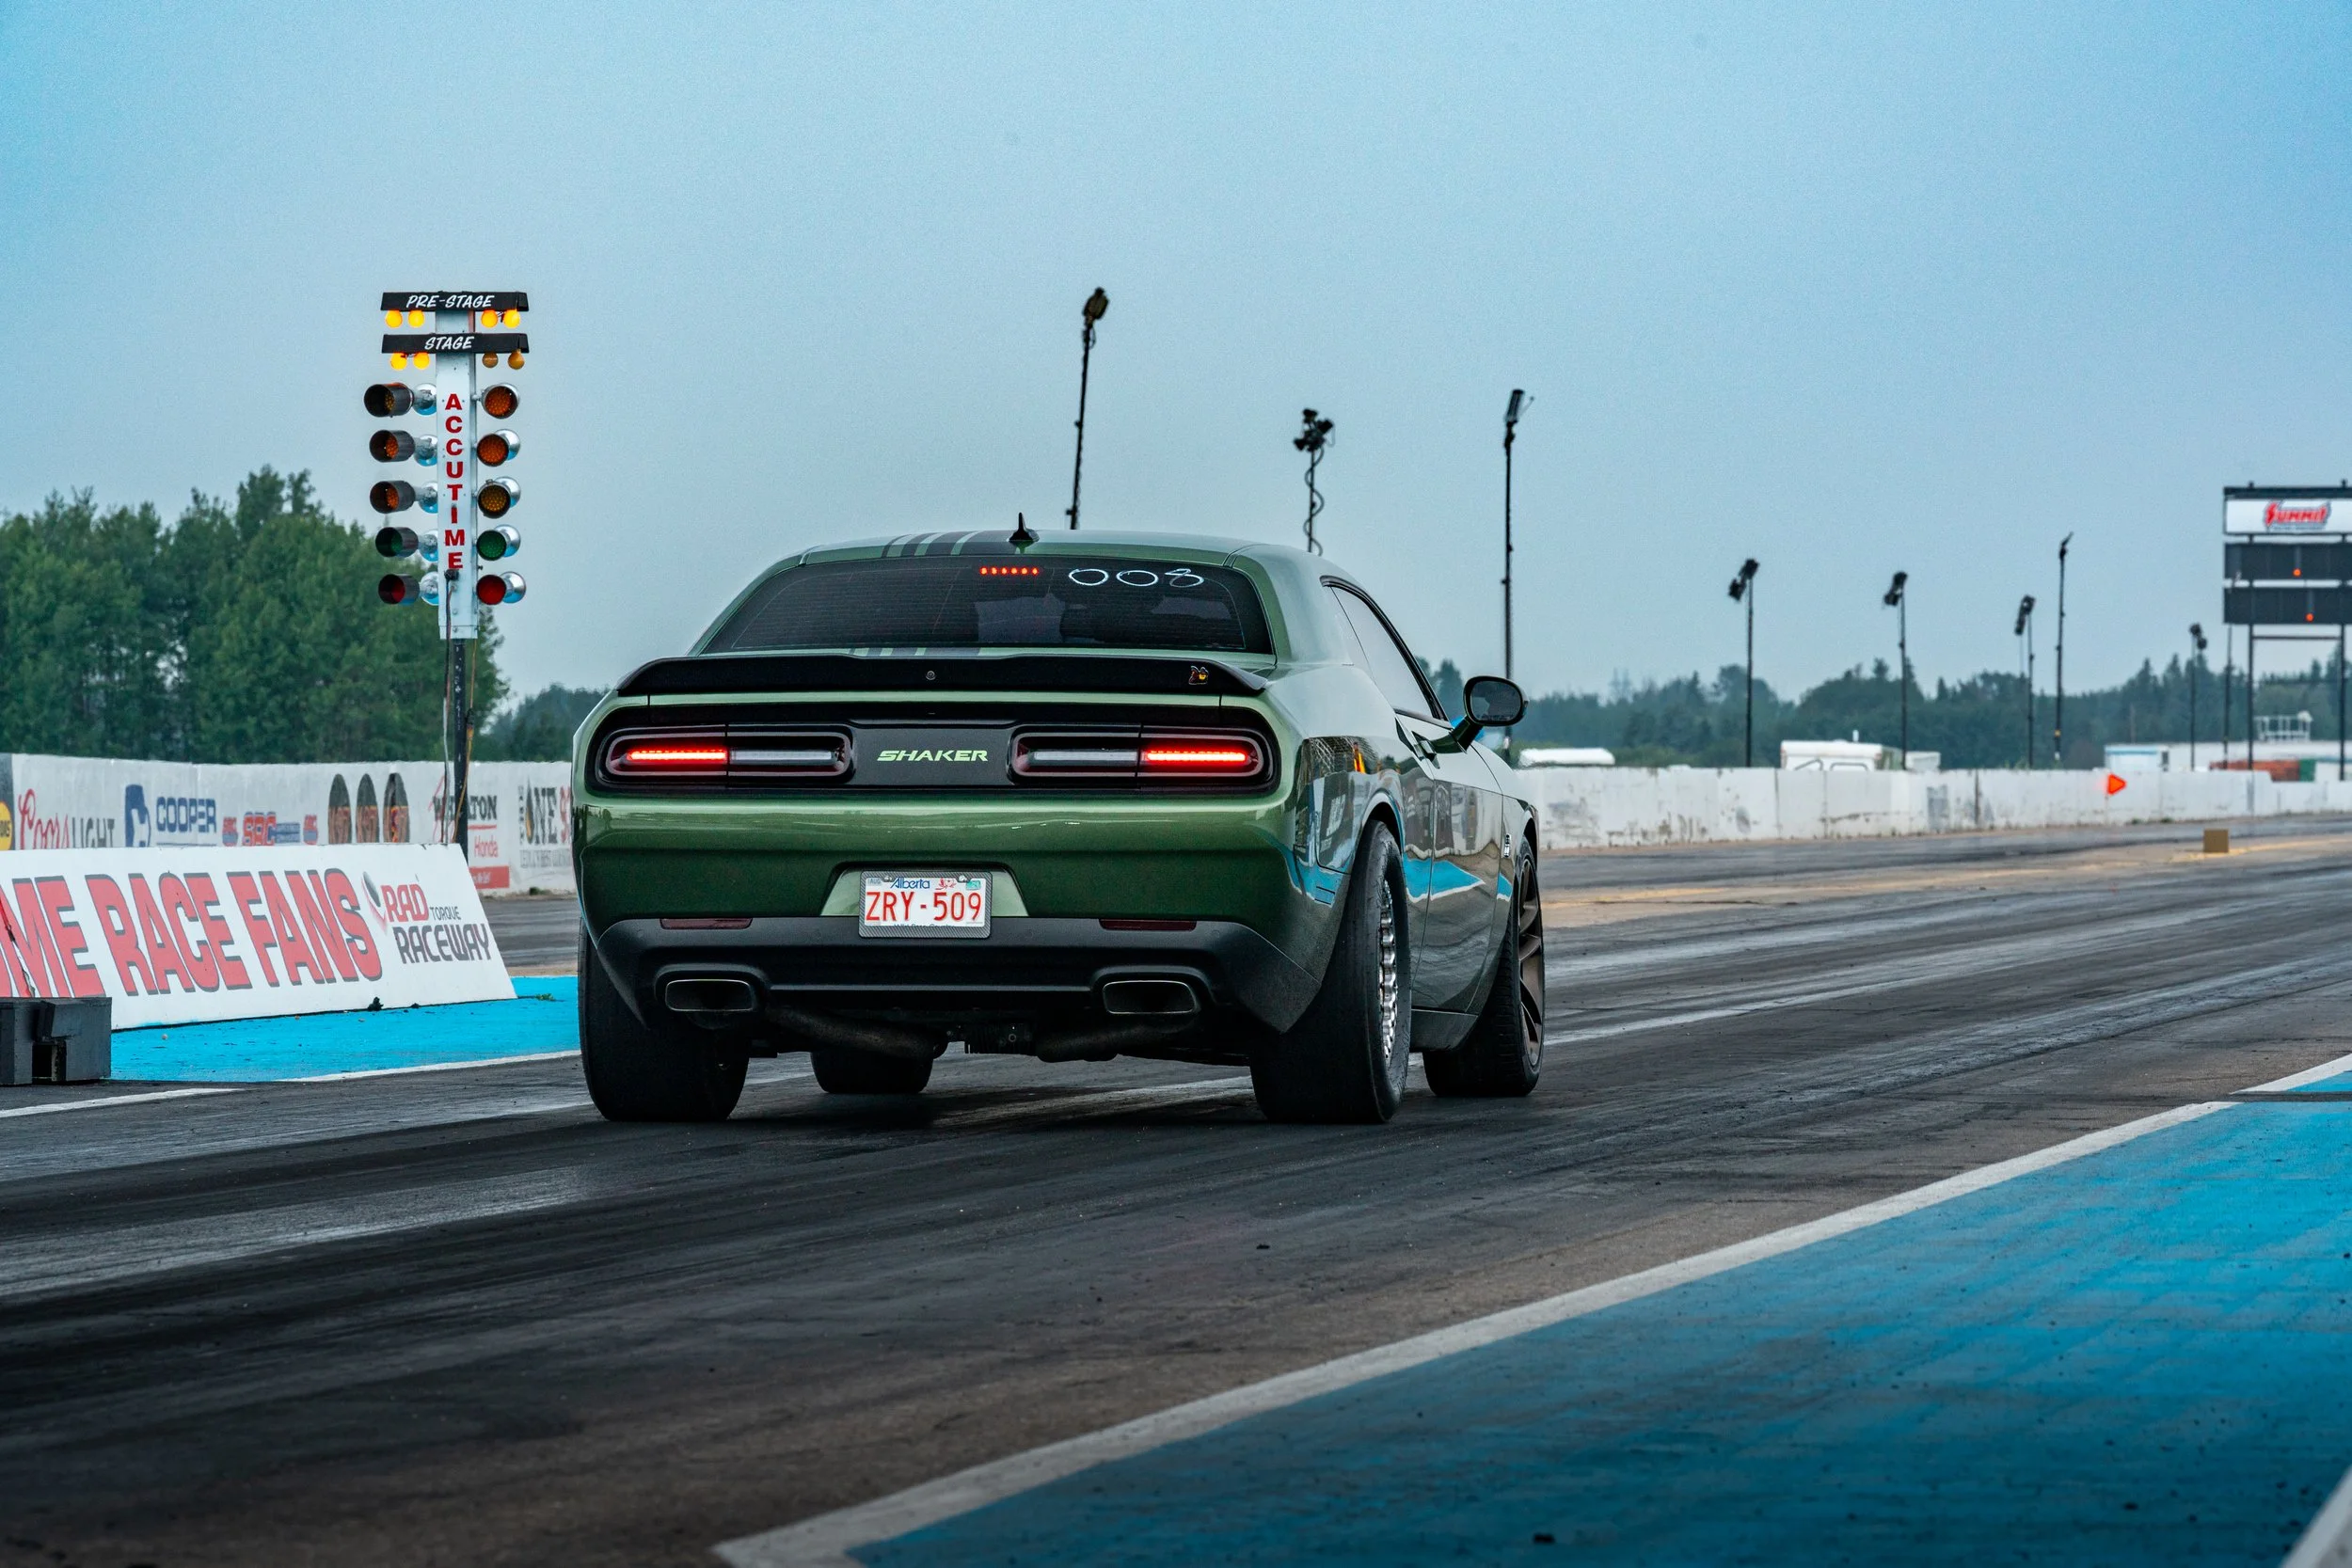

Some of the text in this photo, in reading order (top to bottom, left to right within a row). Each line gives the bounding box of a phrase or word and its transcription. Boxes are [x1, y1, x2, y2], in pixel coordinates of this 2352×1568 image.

[405, 294, 495, 309] PRE-STAGE
[424, 336, 474, 350] STAGE
[444, 393, 466, 570] ACCUTIME
[877, 750, 988, 762] SHAKER
[156, 796, 217, 833] COOPER
[474, 834, 499, 857] Honda
[890, 876, 930, 890] Alberta
[380, 884, 462, 923] RAD TORQUE
[866, 891, 982, 922] ZRY-509
[85, 872, 253, 997] RACE
[227, 868, 383, 988] FANS
[392, 923, 492, 965] RACEWAY
